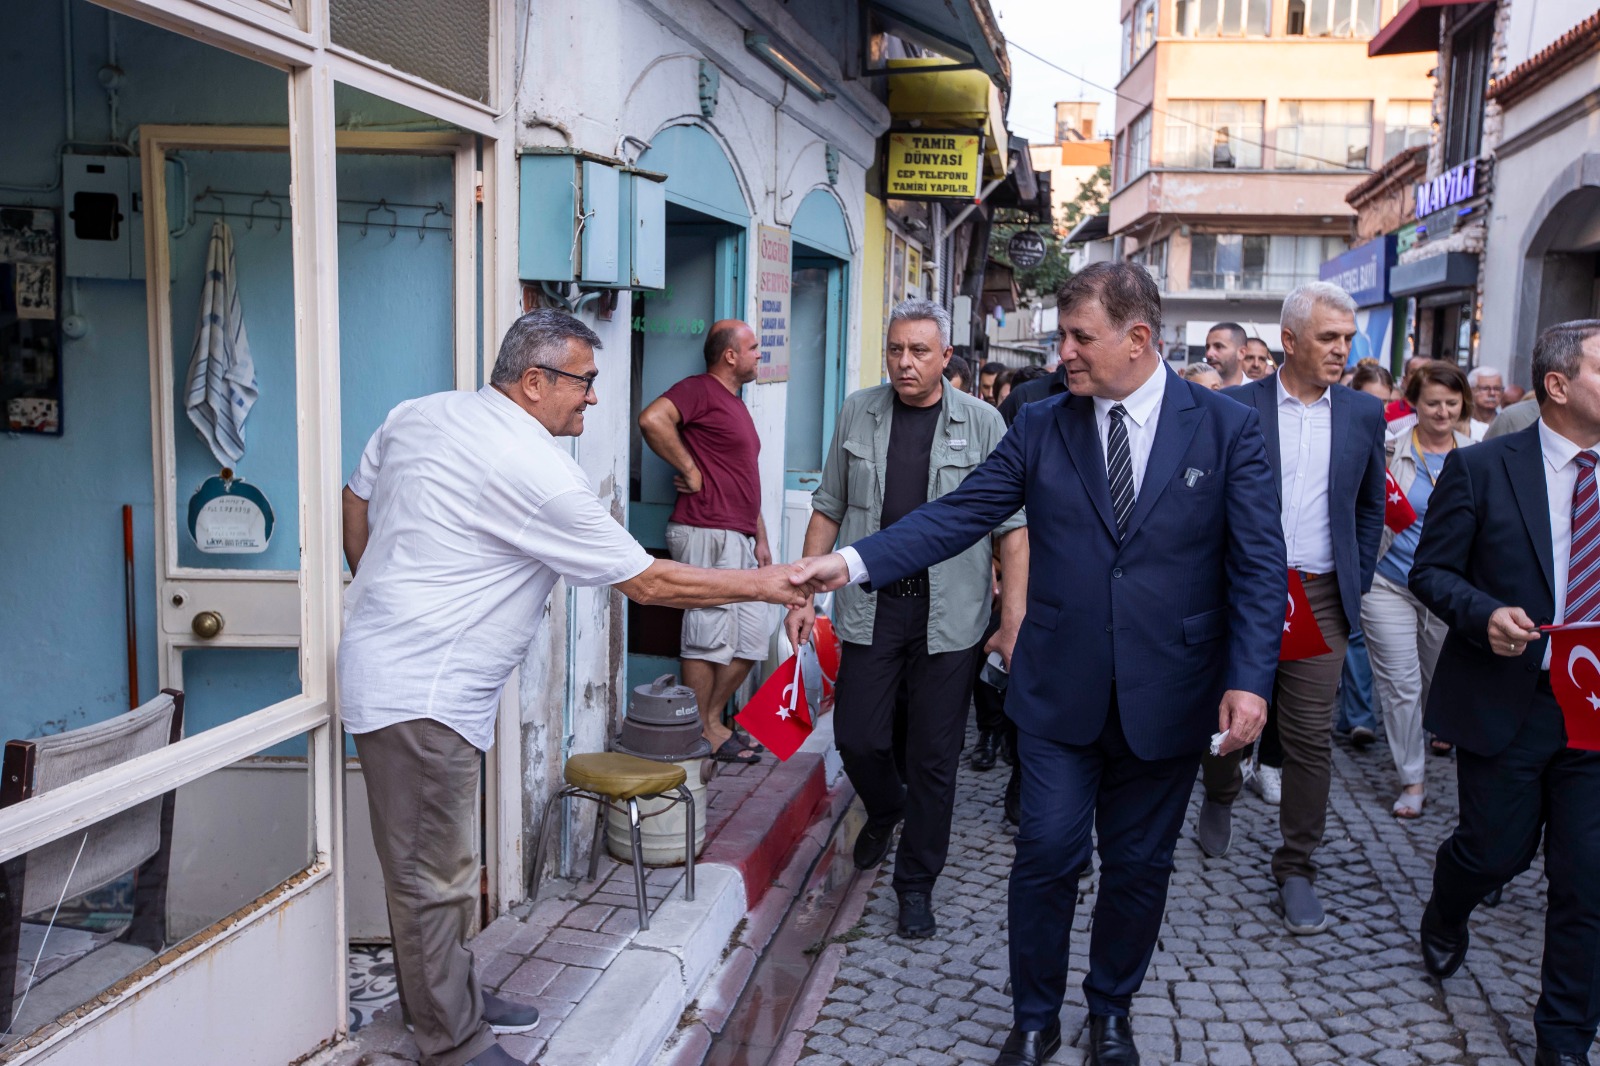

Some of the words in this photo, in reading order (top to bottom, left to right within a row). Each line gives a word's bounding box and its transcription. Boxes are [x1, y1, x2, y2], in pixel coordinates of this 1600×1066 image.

[912, 135, 956, 150] TAMİR
[897, 170, 916, 178] CEP
[918, 170, 968, 180] TELEFONU
[893, 181, 927, 191] TAMİRİ
[761, 234, 789, 264] ÖZGÜR
[1010, 239, 1044, 252] PALA
[760, 269, 789, 294] SERVİS
